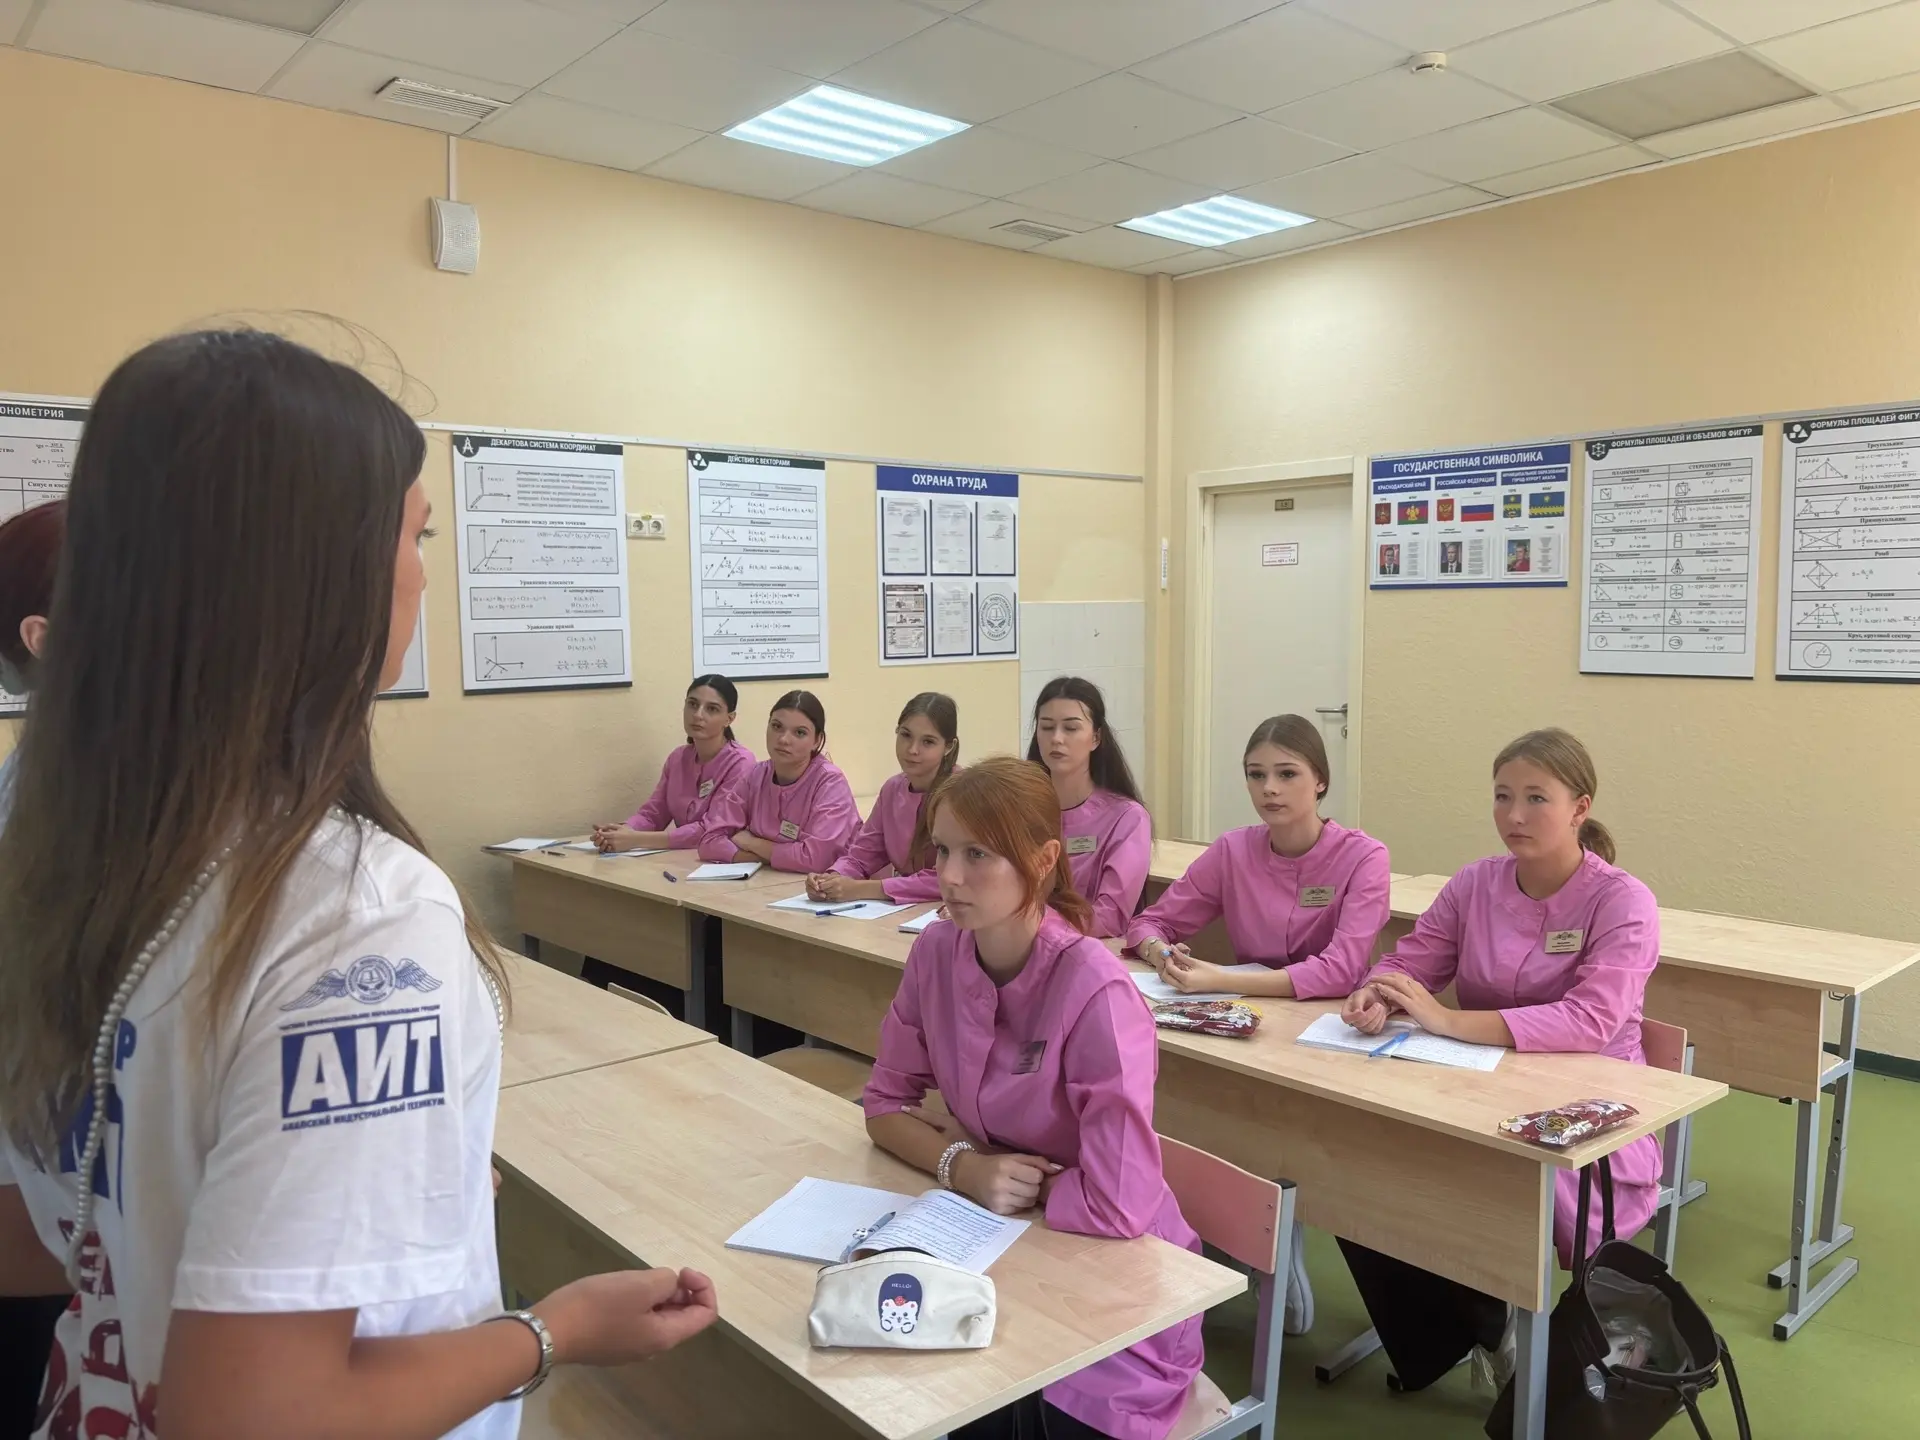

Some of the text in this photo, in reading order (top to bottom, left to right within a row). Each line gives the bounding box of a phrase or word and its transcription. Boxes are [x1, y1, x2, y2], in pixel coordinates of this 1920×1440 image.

[1810, 412, 1920, 429] ФОРМУЛЫ ПЛОЩАДЕЙ ФИГУ
[491, 438, 597, 452] ДЕКАРТОВА СИСТЕМА КООРДИНАТ
[1611, 428, 1753, 449] ФОРМУЛЫ ПЛОЩАДЕЙ И ОБЪЕМОВ ФИГУР
[1867, 441, 1904, 450] Треугольник
[728, 455, 756, 464] ДЕЙСТВИЯ
[761, 458, 791, 466] ВЕКТОРАМИ
[1393, 450, 1544, 474] ГОСУДАРСТВЕННАЯ СИМВОЛИКА
[911, 474, 988, 490] ОХРАНА ТРУДА
[1377, 481, 1413, 490] КРАСНОДАРСКИЙ
[1436, 478, 1467, 486] РОССИЙСКАЯ
[287, 1018, 438, 1114] АИТ
[282, 1097, 445, 1131] АНАПСКИЙ ИНДУСТРИАЛЬНЫЙ ТЕХНИКУМ
